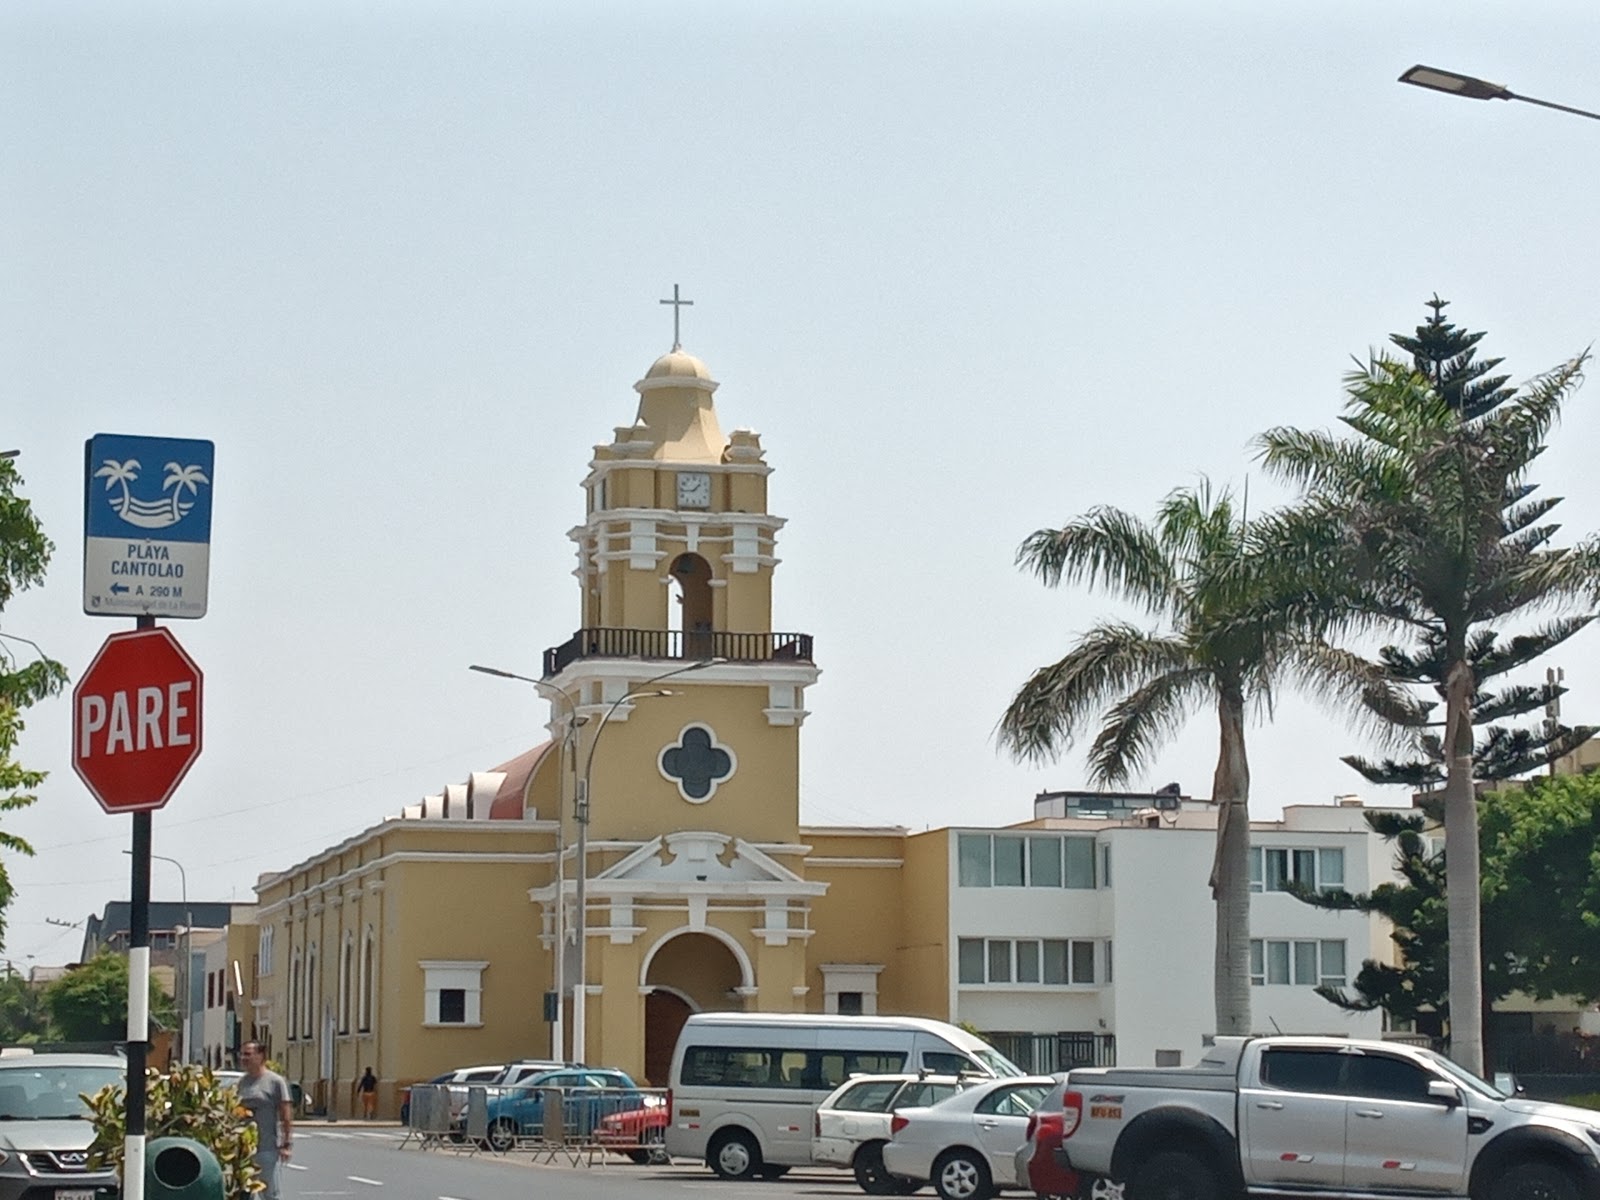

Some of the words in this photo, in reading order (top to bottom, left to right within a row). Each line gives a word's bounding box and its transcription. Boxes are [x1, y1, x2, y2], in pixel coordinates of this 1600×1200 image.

[127, 544, 169, 560] PLAYA
[111, 560, 184, 578] CANTOLAO
[135, 585, 144, 596] A
[150, 586, 170, 597] 290
[173, 587, 183, 598] M
[81, 680, 192, 758] PARE
